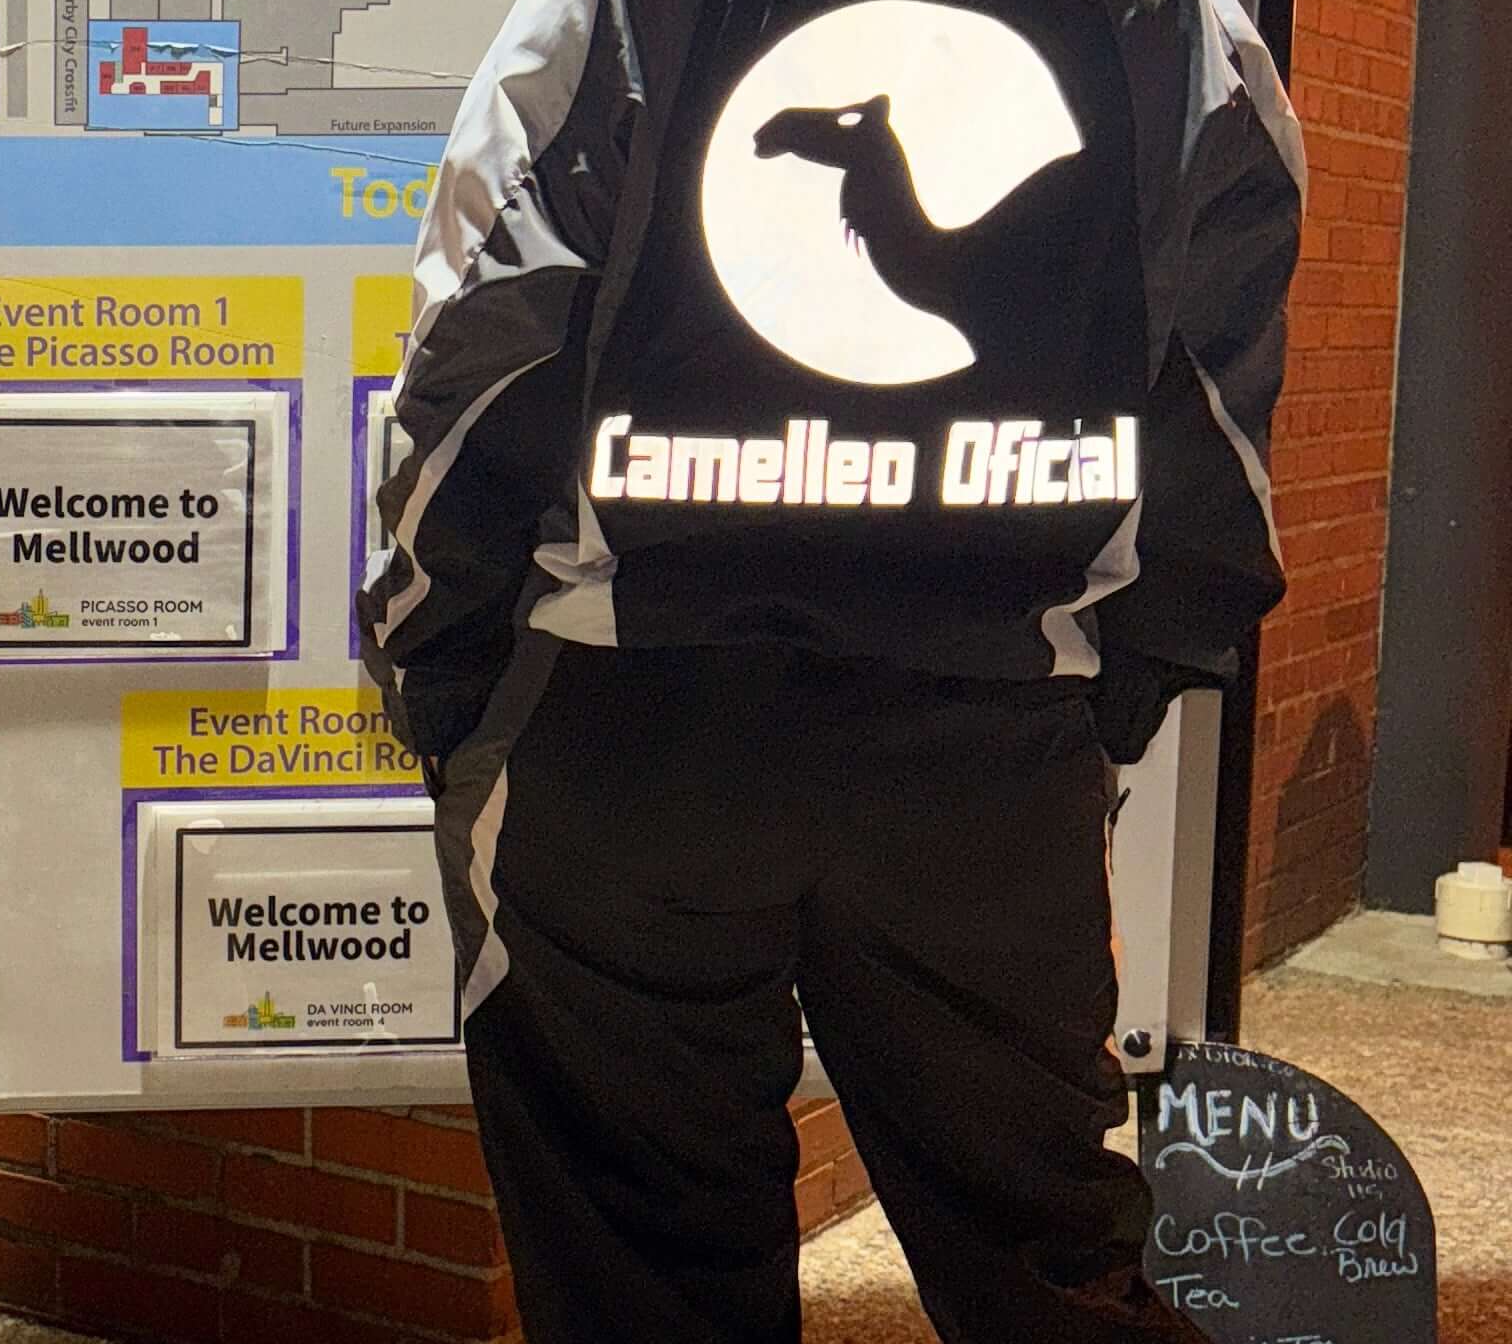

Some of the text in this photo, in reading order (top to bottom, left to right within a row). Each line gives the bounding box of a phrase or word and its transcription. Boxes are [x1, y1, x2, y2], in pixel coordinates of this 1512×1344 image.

[62, 26, 78, 55] City
[64, 58, 78, 113] Crossfit
[330, 119, 437, 134] Future Expansion
[328, 164, 438, 219] Tod
[96, 296, 201, 327] Room
[214, 297, 229, 326] 1
[27, 335, 159, 367] Picasso
[171, 336, 275, 366] Room
[590, 413, 916, 505] Camelleo
[179, 491, 218, 519] to
[13, 532, 200, 564] Mellwood
[81, 601, 202, 613] PICASSO ROOM
[82, 618, 115, 627] event
[119, 618, 149, 626] room
[190, 706, 289, 737] Event
[153, 744, 218, 775] The
[229, 743, 363, 774] DaVinci
[208, 896, 430, 927] Welcome to
[226, 928, 412, 962] Mellwood
[307, 1002, 413, 1015] DA VINCI ROOM
[307, 1017, 385, 1028] event room 4
[1157, 1081, 1320, 1147] MENU
[1322, 1154, 1398, 1180] Studio
[1155, 1211, 1406, 1257] Coffee Cold
[1338, 1251, 1417, 1281] Brew
[1156, 1273, 1239, 1309] Tea
